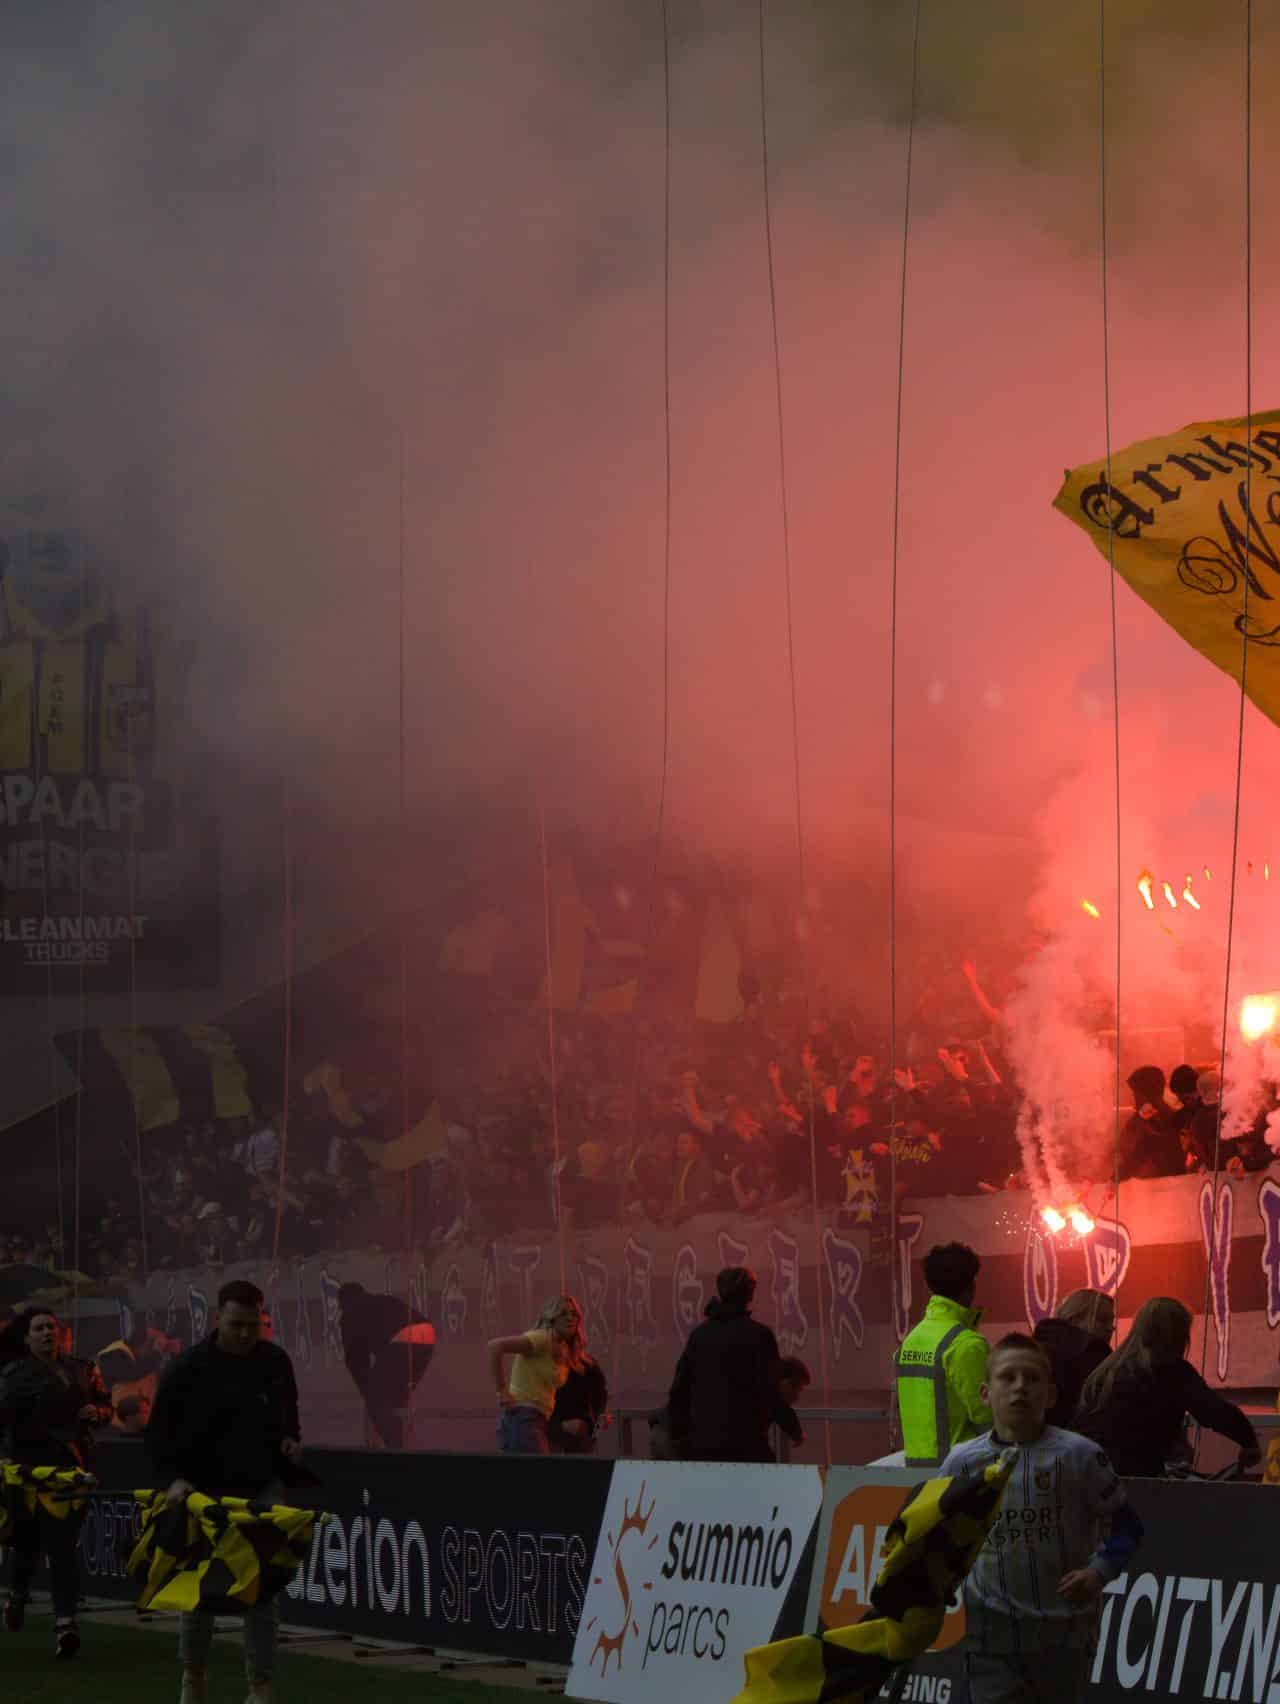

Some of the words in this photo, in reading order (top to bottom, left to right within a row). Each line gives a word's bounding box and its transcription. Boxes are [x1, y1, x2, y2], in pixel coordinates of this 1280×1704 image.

[0, 774, 145, 832] PAAR
[24, 942, 109, 960] TRUCKS
[901, 1350, 934, 1363] SERVICE
[998, 1505, 1064, 1526] PORT
[661, 1506, 793, 1589] summio
[985, 1526, 1051, 1545] SPER
[440, 1525, 587, 1634] SPORTS
[643, 1602, 729, 1670] parcs
